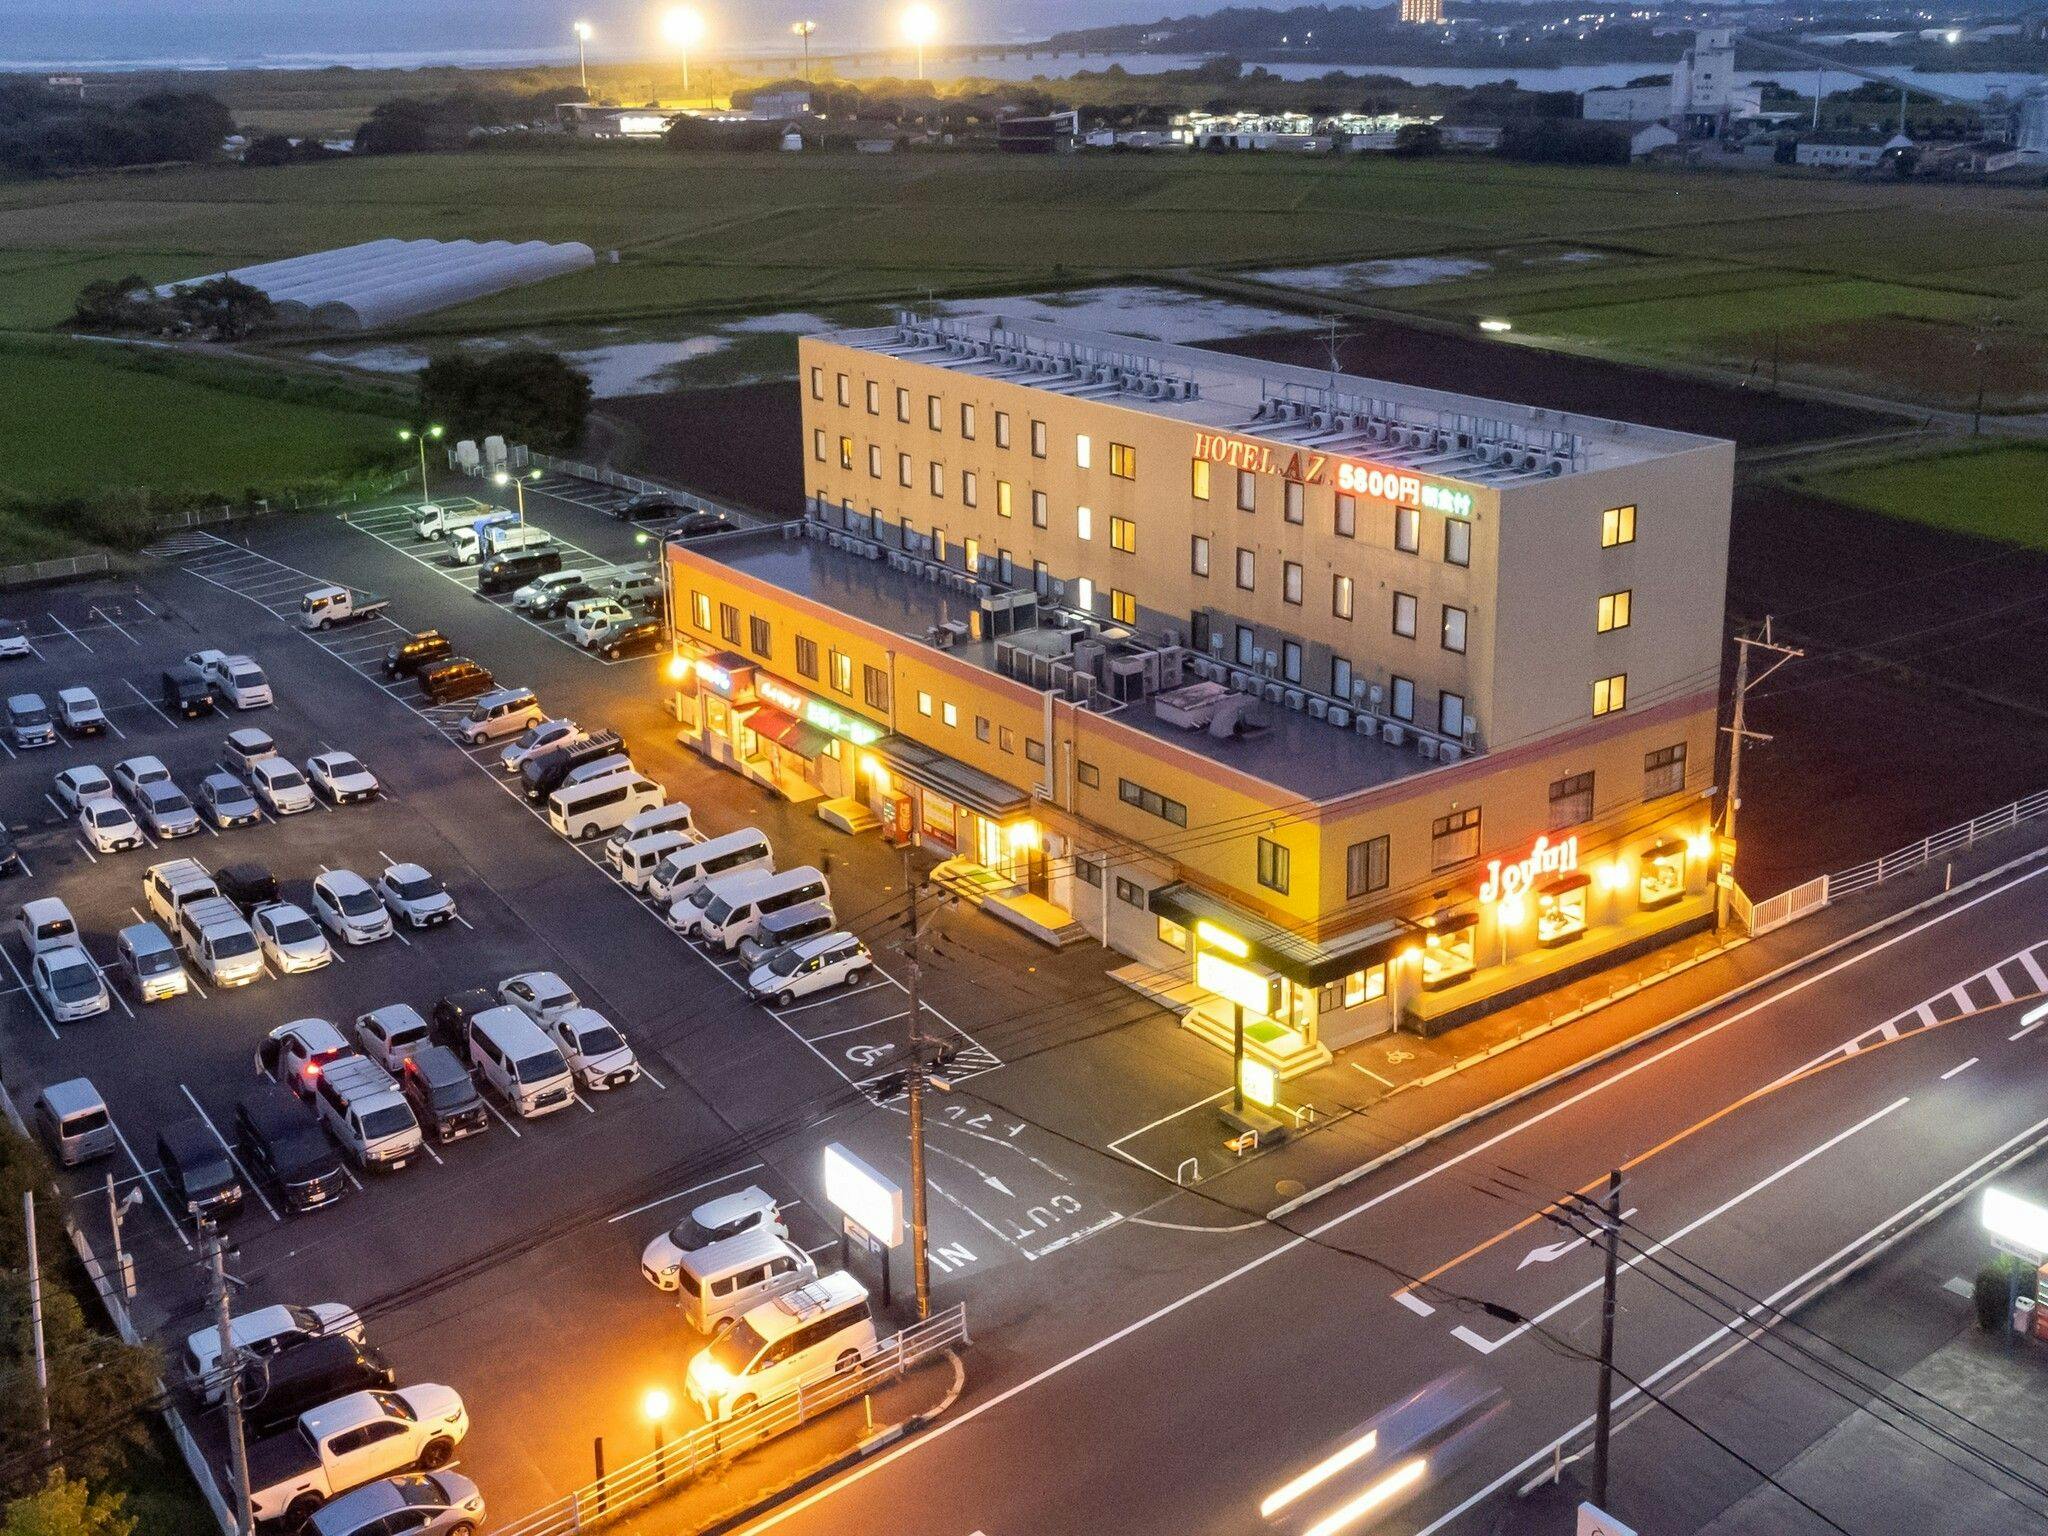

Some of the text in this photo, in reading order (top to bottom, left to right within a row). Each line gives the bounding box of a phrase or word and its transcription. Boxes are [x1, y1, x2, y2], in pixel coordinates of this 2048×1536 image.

[1195, 433, 1328, 485] HOTEL AZ
[1338, 463, 1421, 506] 5800円
[1479, 836, 1578, 903] Joyfull
[1006, 1194, 1083, 1240] OUT
[926, 1241, 979, 1274] IN
